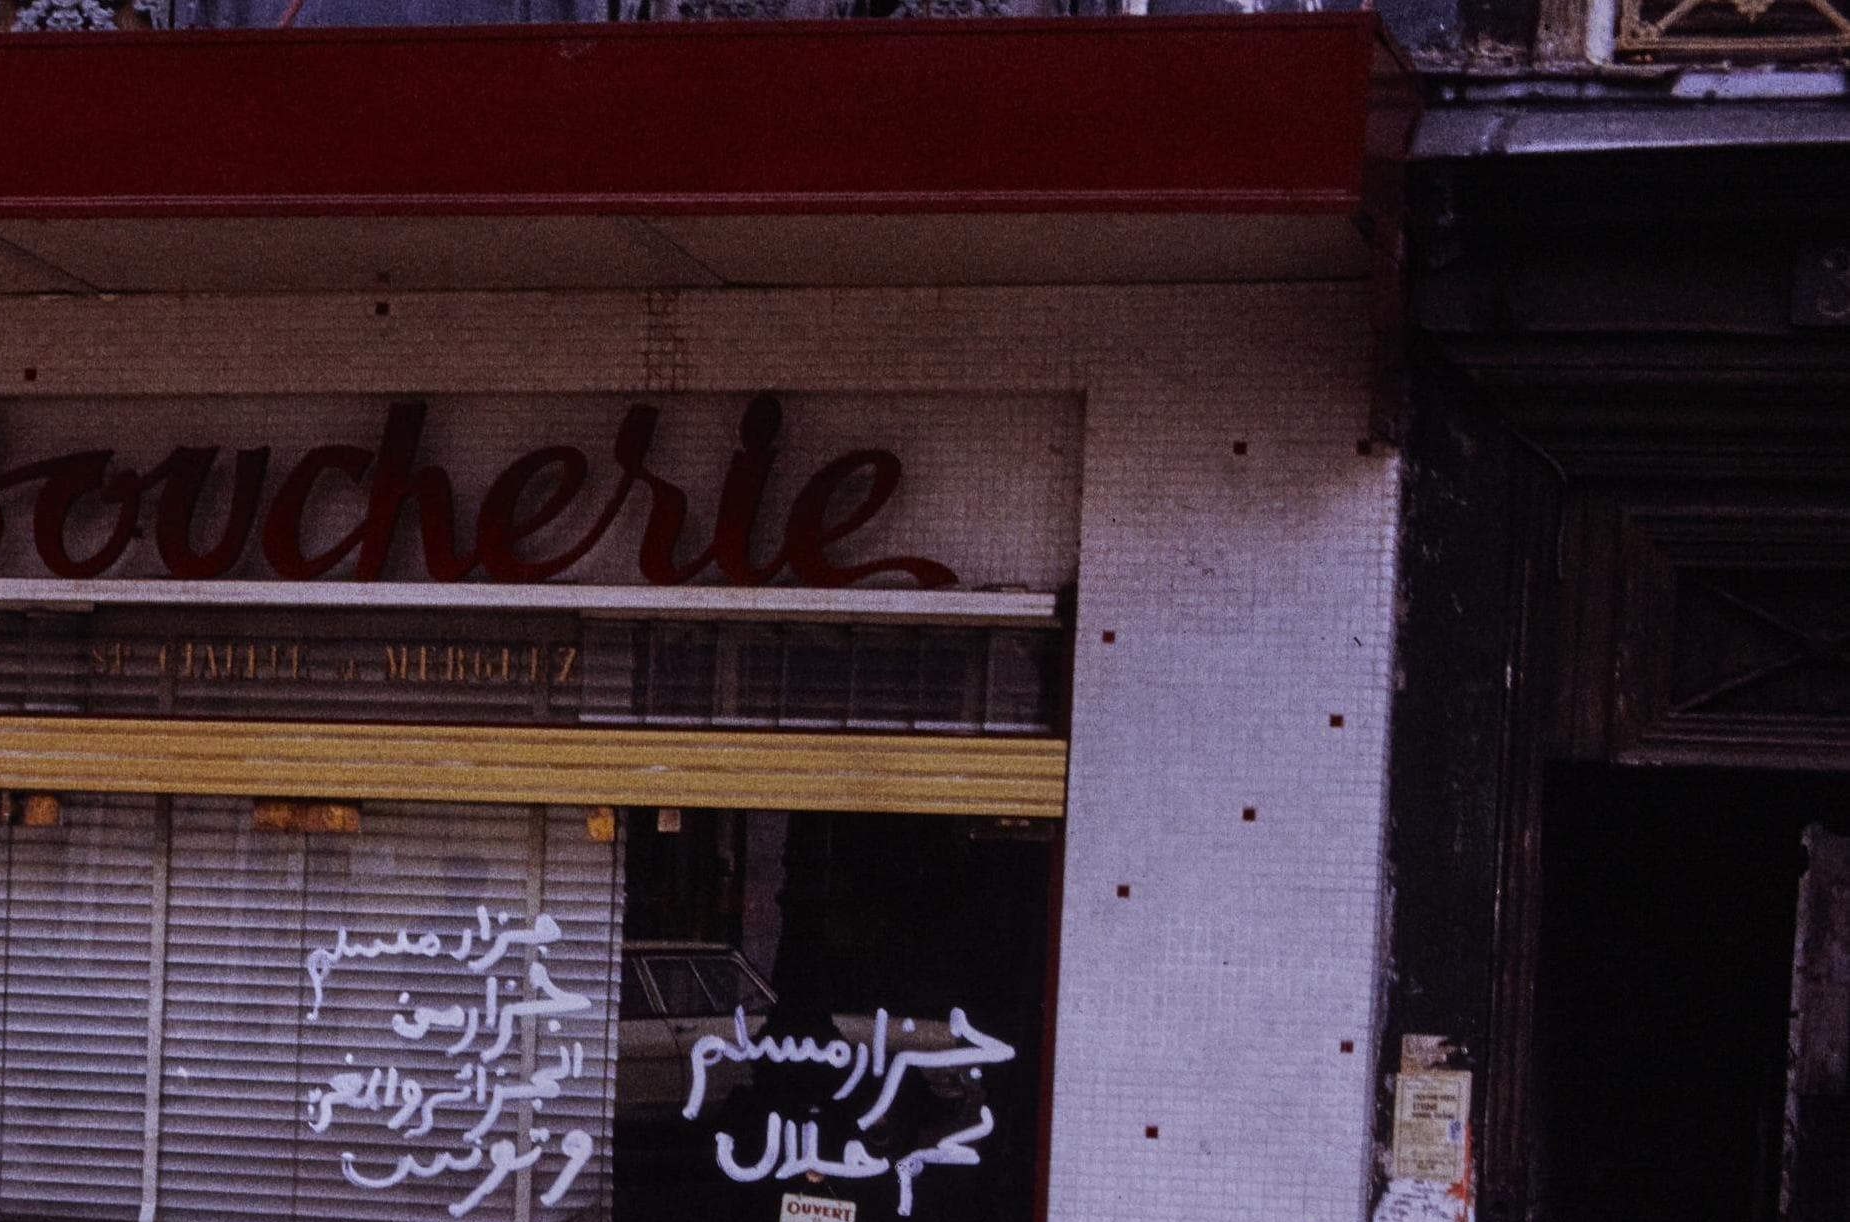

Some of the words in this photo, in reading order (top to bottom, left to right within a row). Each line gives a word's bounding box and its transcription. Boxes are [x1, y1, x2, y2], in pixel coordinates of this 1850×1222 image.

[391, 991, 466, 1040] من
[447, 961, 592, 1063] جزار
[681, 1003, 851, 1121] مسلم
[832, 1006, 1017, 1132] جزار
